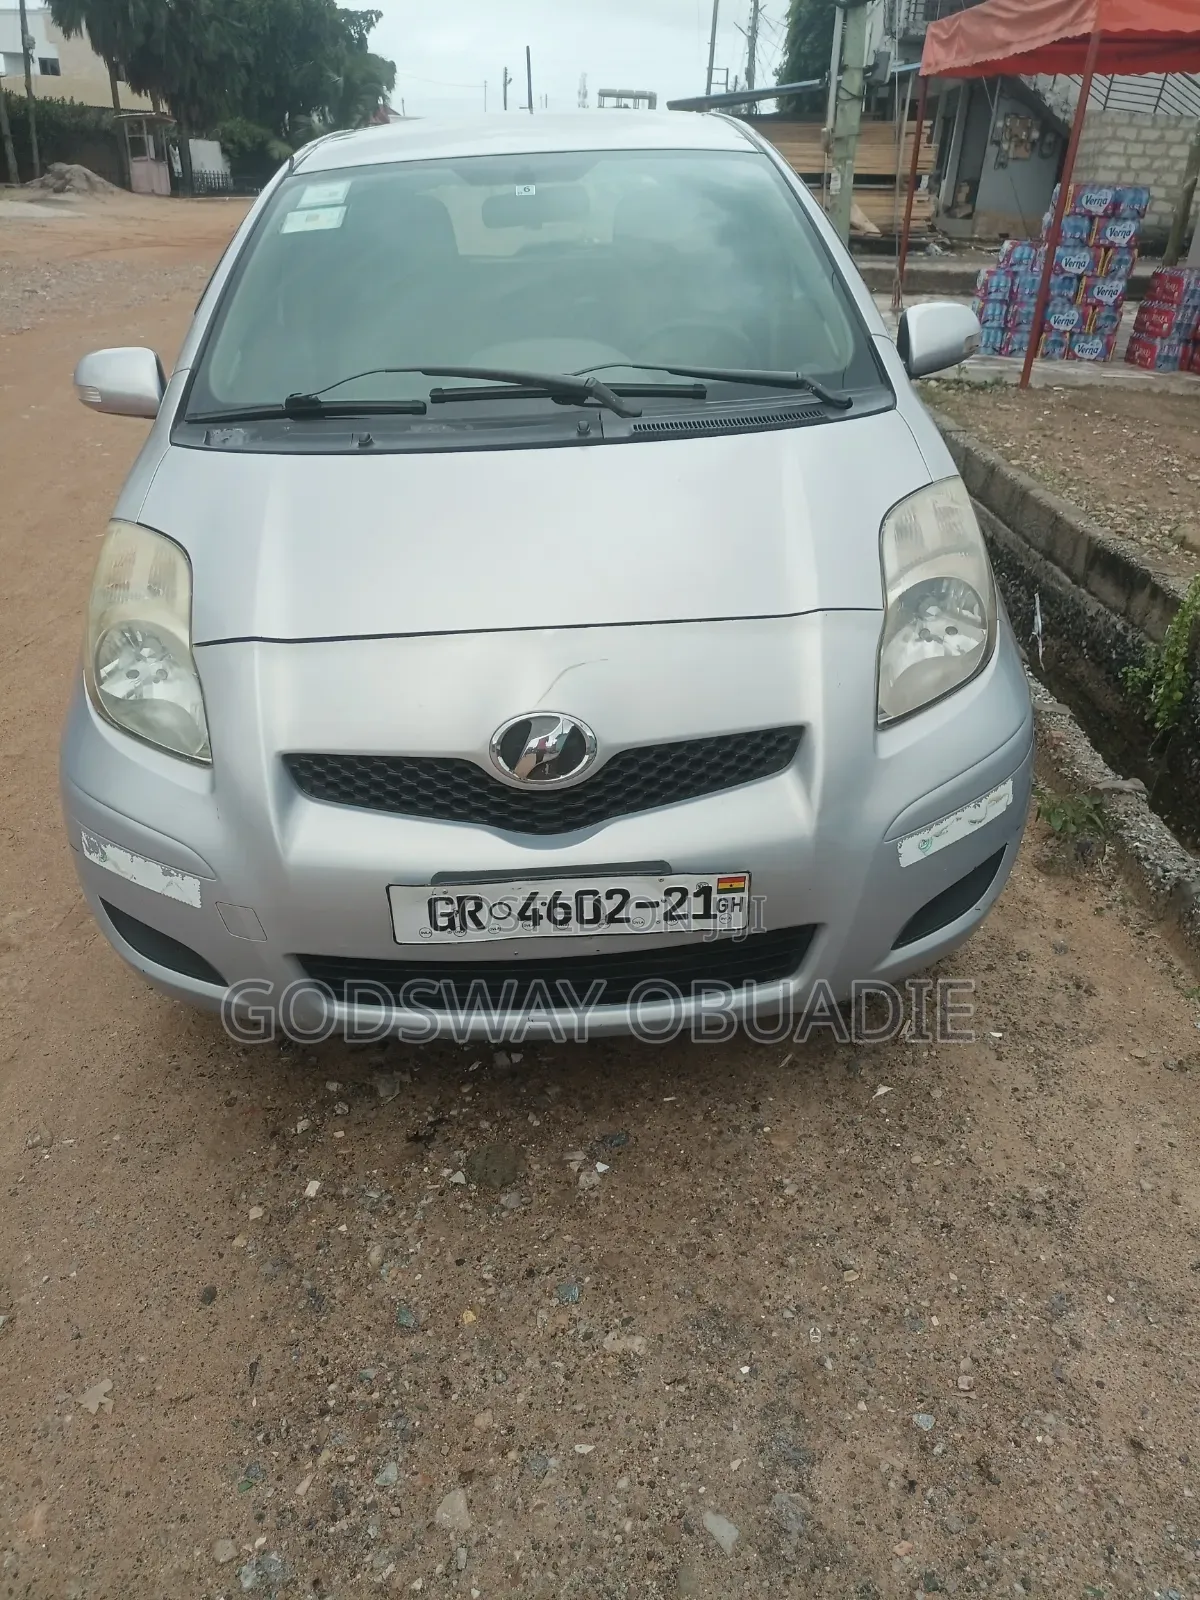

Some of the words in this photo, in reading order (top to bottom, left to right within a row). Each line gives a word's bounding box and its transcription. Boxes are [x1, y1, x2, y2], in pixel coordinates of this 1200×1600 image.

[1085, 195, 1108, 207] Verna
[1109, 227, 1131, 239] Verna
[1063, 258, 1086, 270] Verna
[1096, 286, 1119, 298] Verna
[1052, 315, 1075, 326] Verna
[1077, 345, 1100, 356] Verna
[717, 896, 744, 913] GH
[427, 895, 486, 931] GR
